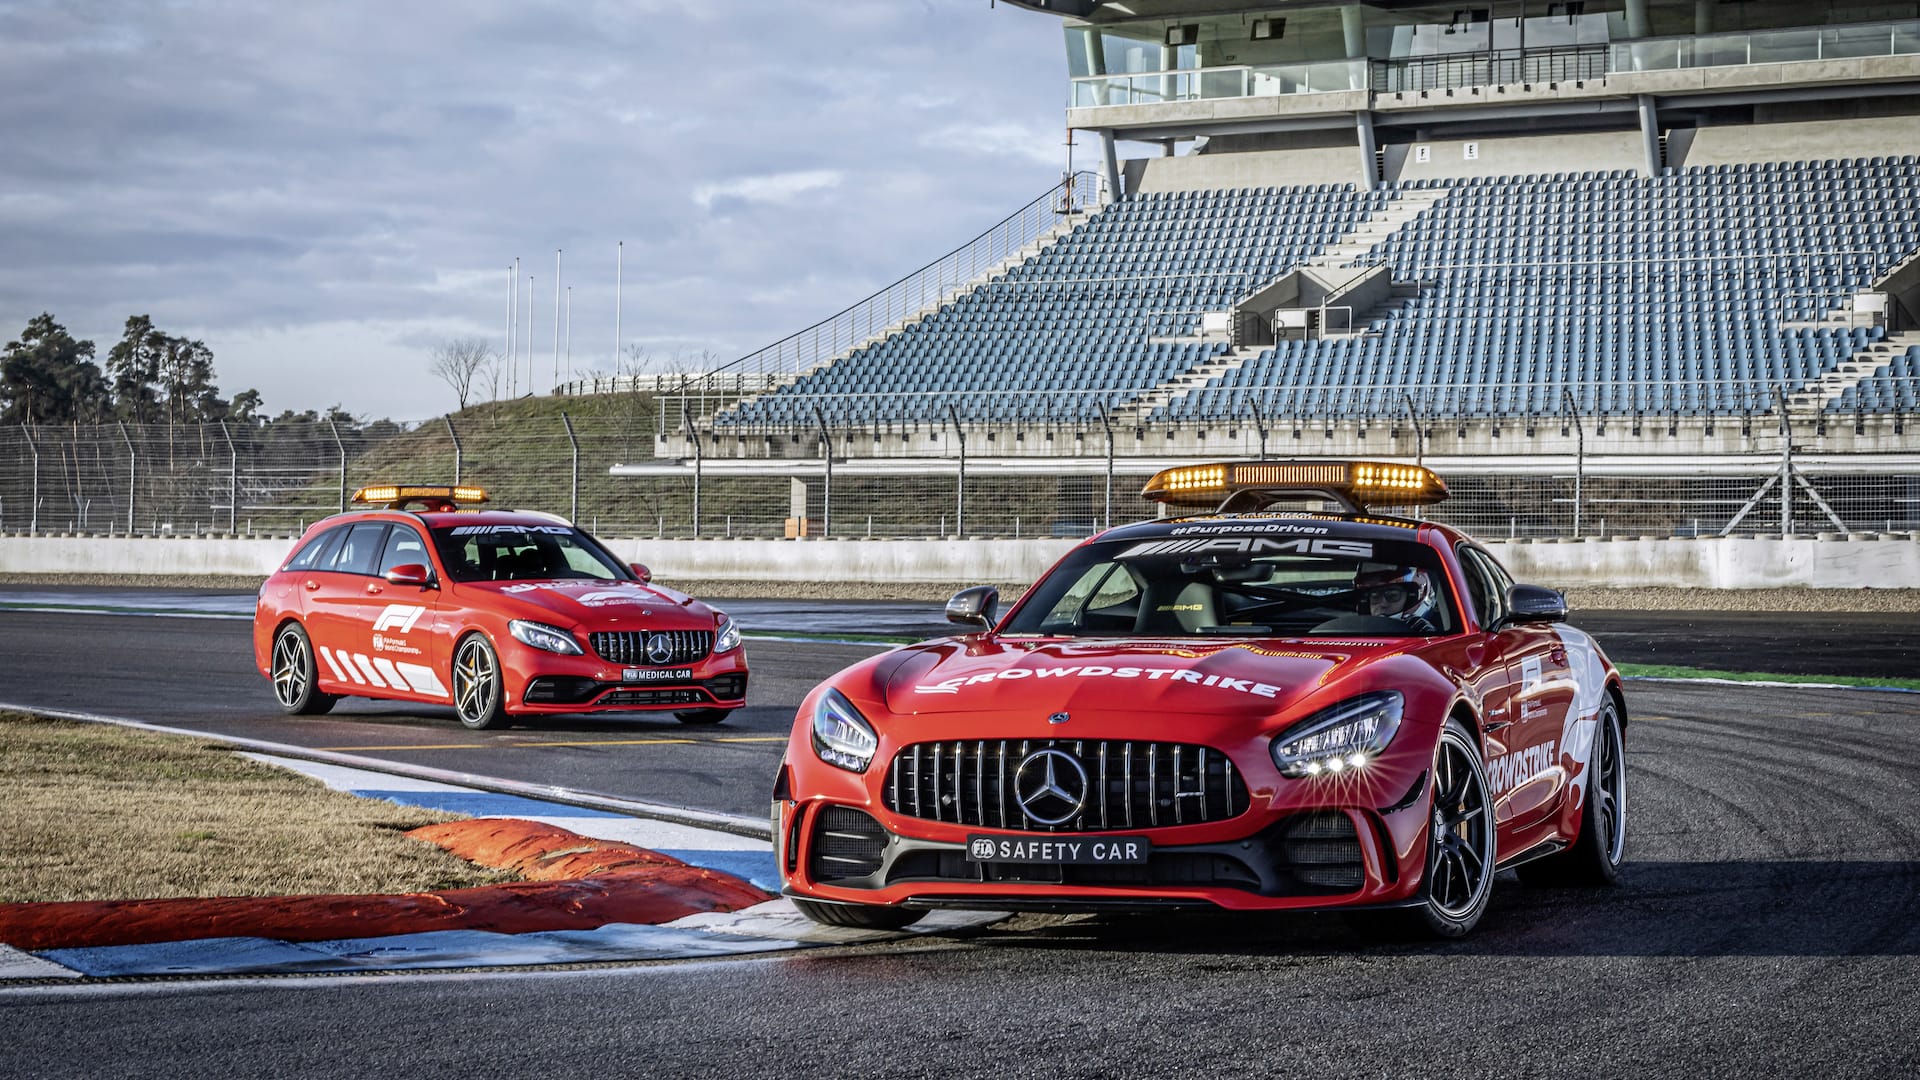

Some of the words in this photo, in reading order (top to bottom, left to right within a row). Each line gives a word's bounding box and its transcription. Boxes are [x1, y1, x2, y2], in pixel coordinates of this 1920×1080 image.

[489, 525, 573, 536] AMG
[1171, 524, 1329, 536] #PurposeDriven
[1190, 538, 1373, 559] AMG
[1172, 604, 1203, 612] AMG
[638, 670, 675, 680] MEDICAL
[675, 669, 691, 679] CAR
[938, 666, 1282, 699] CROWDSTRIKE
[1487, 740, 1556, 795] CROWDSTRIKE
[972, 839, 996, 859] FIA
[1000, 840, 1082, 860] SAFETY
[1092, 842, 1138, 861] CAR
